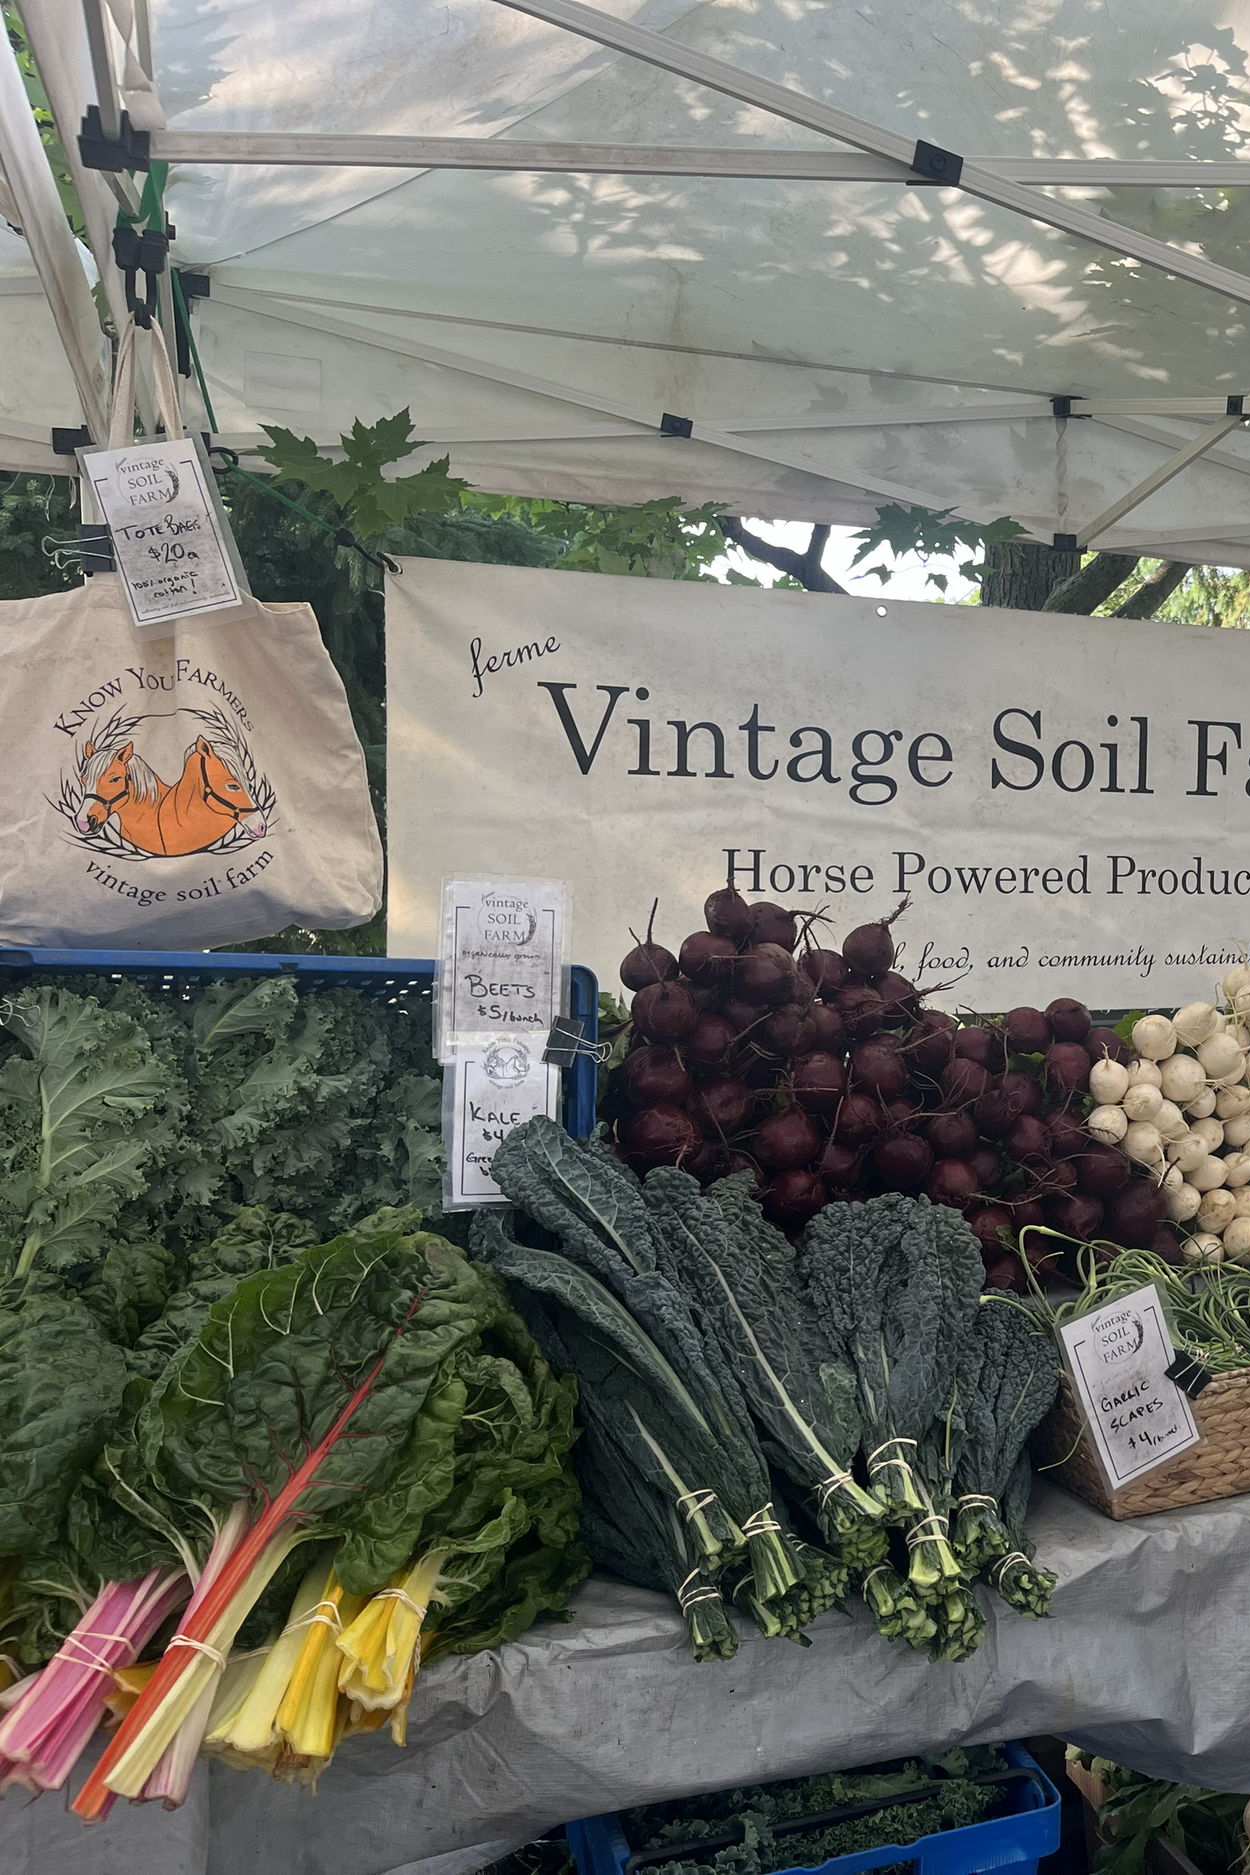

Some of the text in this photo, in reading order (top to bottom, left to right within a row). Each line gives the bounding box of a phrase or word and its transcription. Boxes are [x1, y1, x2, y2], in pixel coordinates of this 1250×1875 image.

[119, 458, 165, 475] vintage
[127, 473, 163, 489] SOIL
[129, 488, 173, 506] FARM
[114, 524, 165, 541] TOTE
[148, 542, 185, 564] $20
[158, 571, 199, 587] organic
[470, 636, 562, 699] ferme
[53, 677, 123, 738] KNOW
[176, 659, 254, 732] FARMERS
[537, 681, 953, 805] Vintage
[991, 708, 1154, 793] Soil
[85, 850, 274, 907] vintage soil farm
[722, 848, 875, 894] Horse
[892, 851, 1092, 895] Powered
[485, 897, 529, 911] vintage
[487, 913, 521, 925] SOIL
[484, 930, 526, 941] FARM
[911, 941, 974, 983] food,
[987, 946, 1030, 968] and
[1038, 944, 1156, 978] community
[464, 974, 536, 999] BEETS
[469, 1101, 521, 1125] KALE
[466, 1152, 492, 1164] Gree
[1094, 1310, 1132, 1333] vintage
[1101, 1327, 1130, 1347] SOIL
[1103, 1339, 1139, 1363] FARM
[1101, 1381, 1150, 1412] GARLIC
[1110, 1398, 1164, 1434] SCAPES
